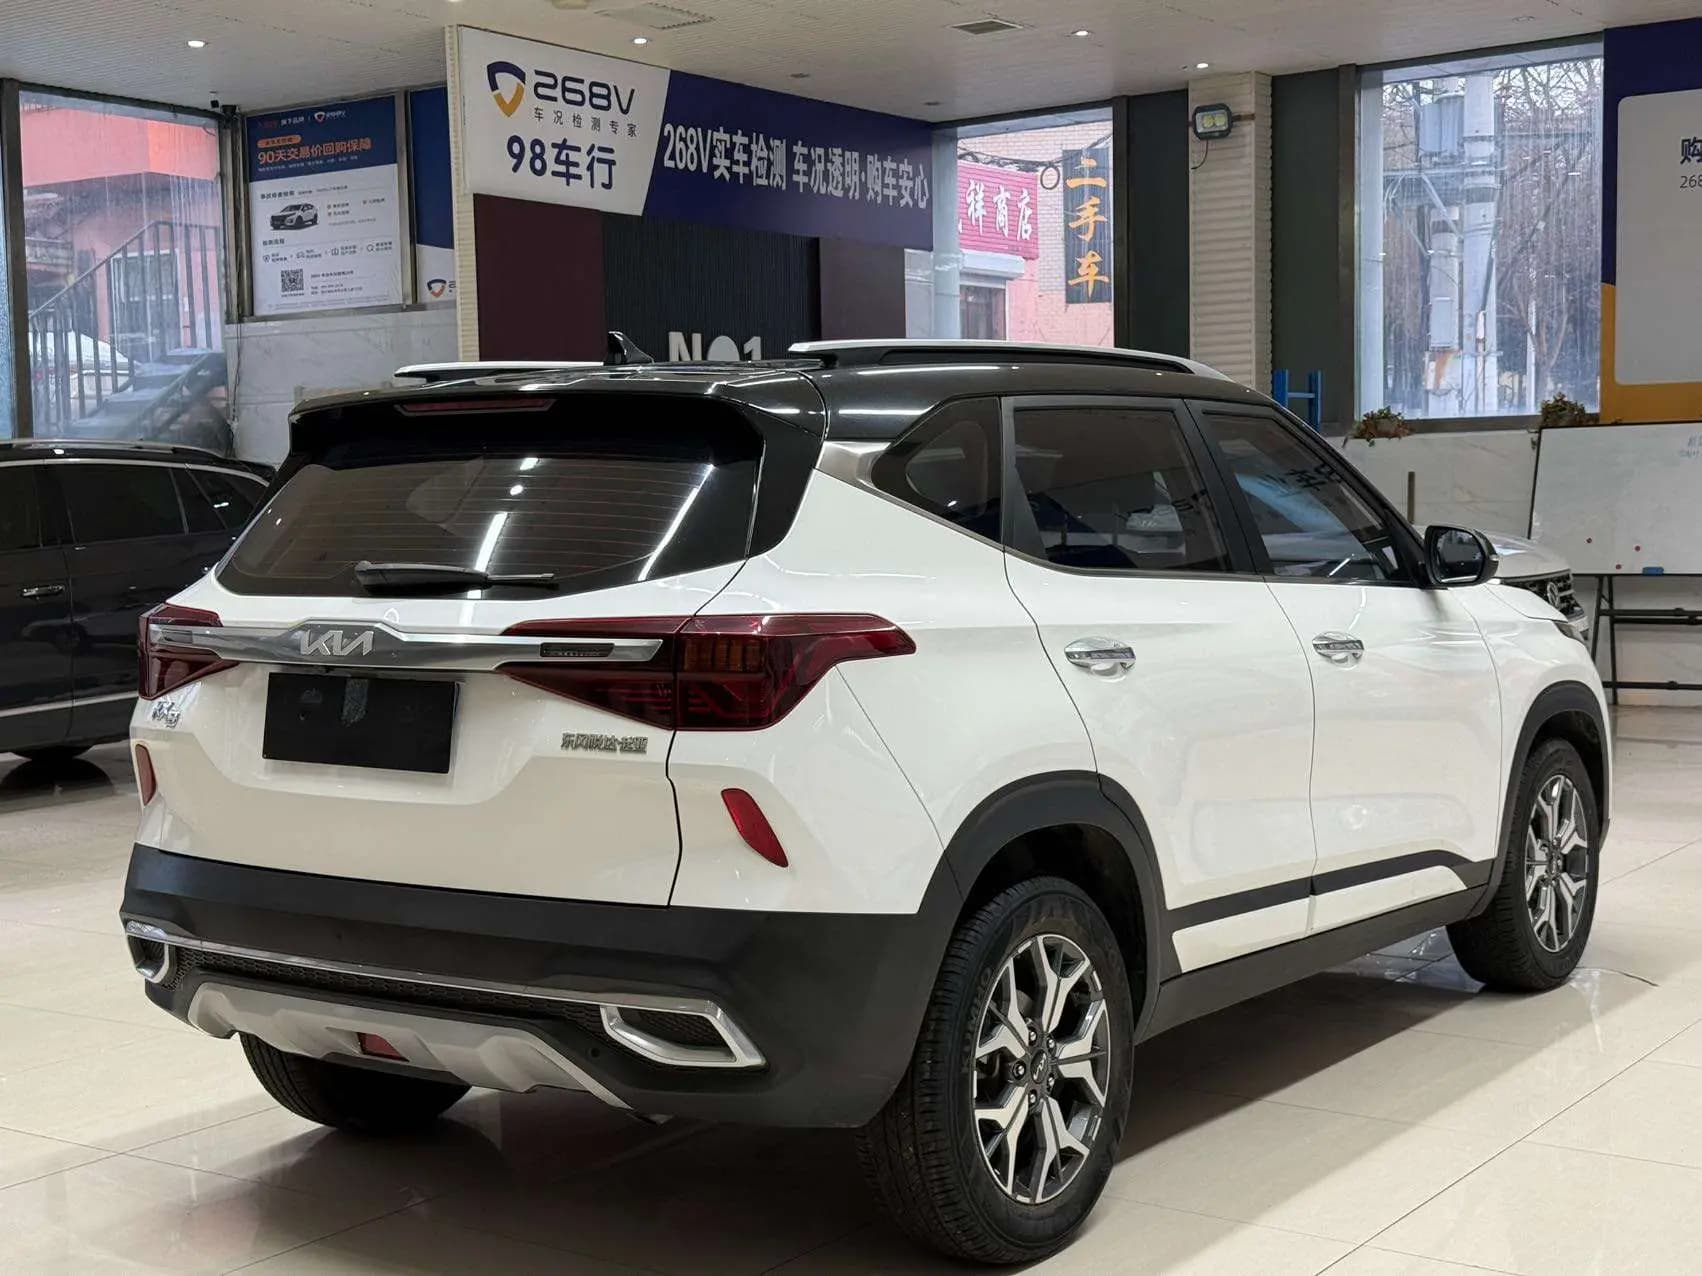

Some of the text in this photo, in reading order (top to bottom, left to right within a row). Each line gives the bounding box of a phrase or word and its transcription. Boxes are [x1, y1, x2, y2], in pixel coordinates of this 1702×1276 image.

[533, 69, 636, 116] 268V
[533, 106, 638, 138] 车况检测专家
[257, 137, 373, 165] 90天交易价回购保障
[506, 134, 617, 190] 98车行
[663, 123, 929, 209] 268V实车检测 车况透明·购车安心
[958, 179, 1033, 242] 祥商店
[1065, 157, 1111, 298] 二手车
[300, 630, 374, 656] KIA
